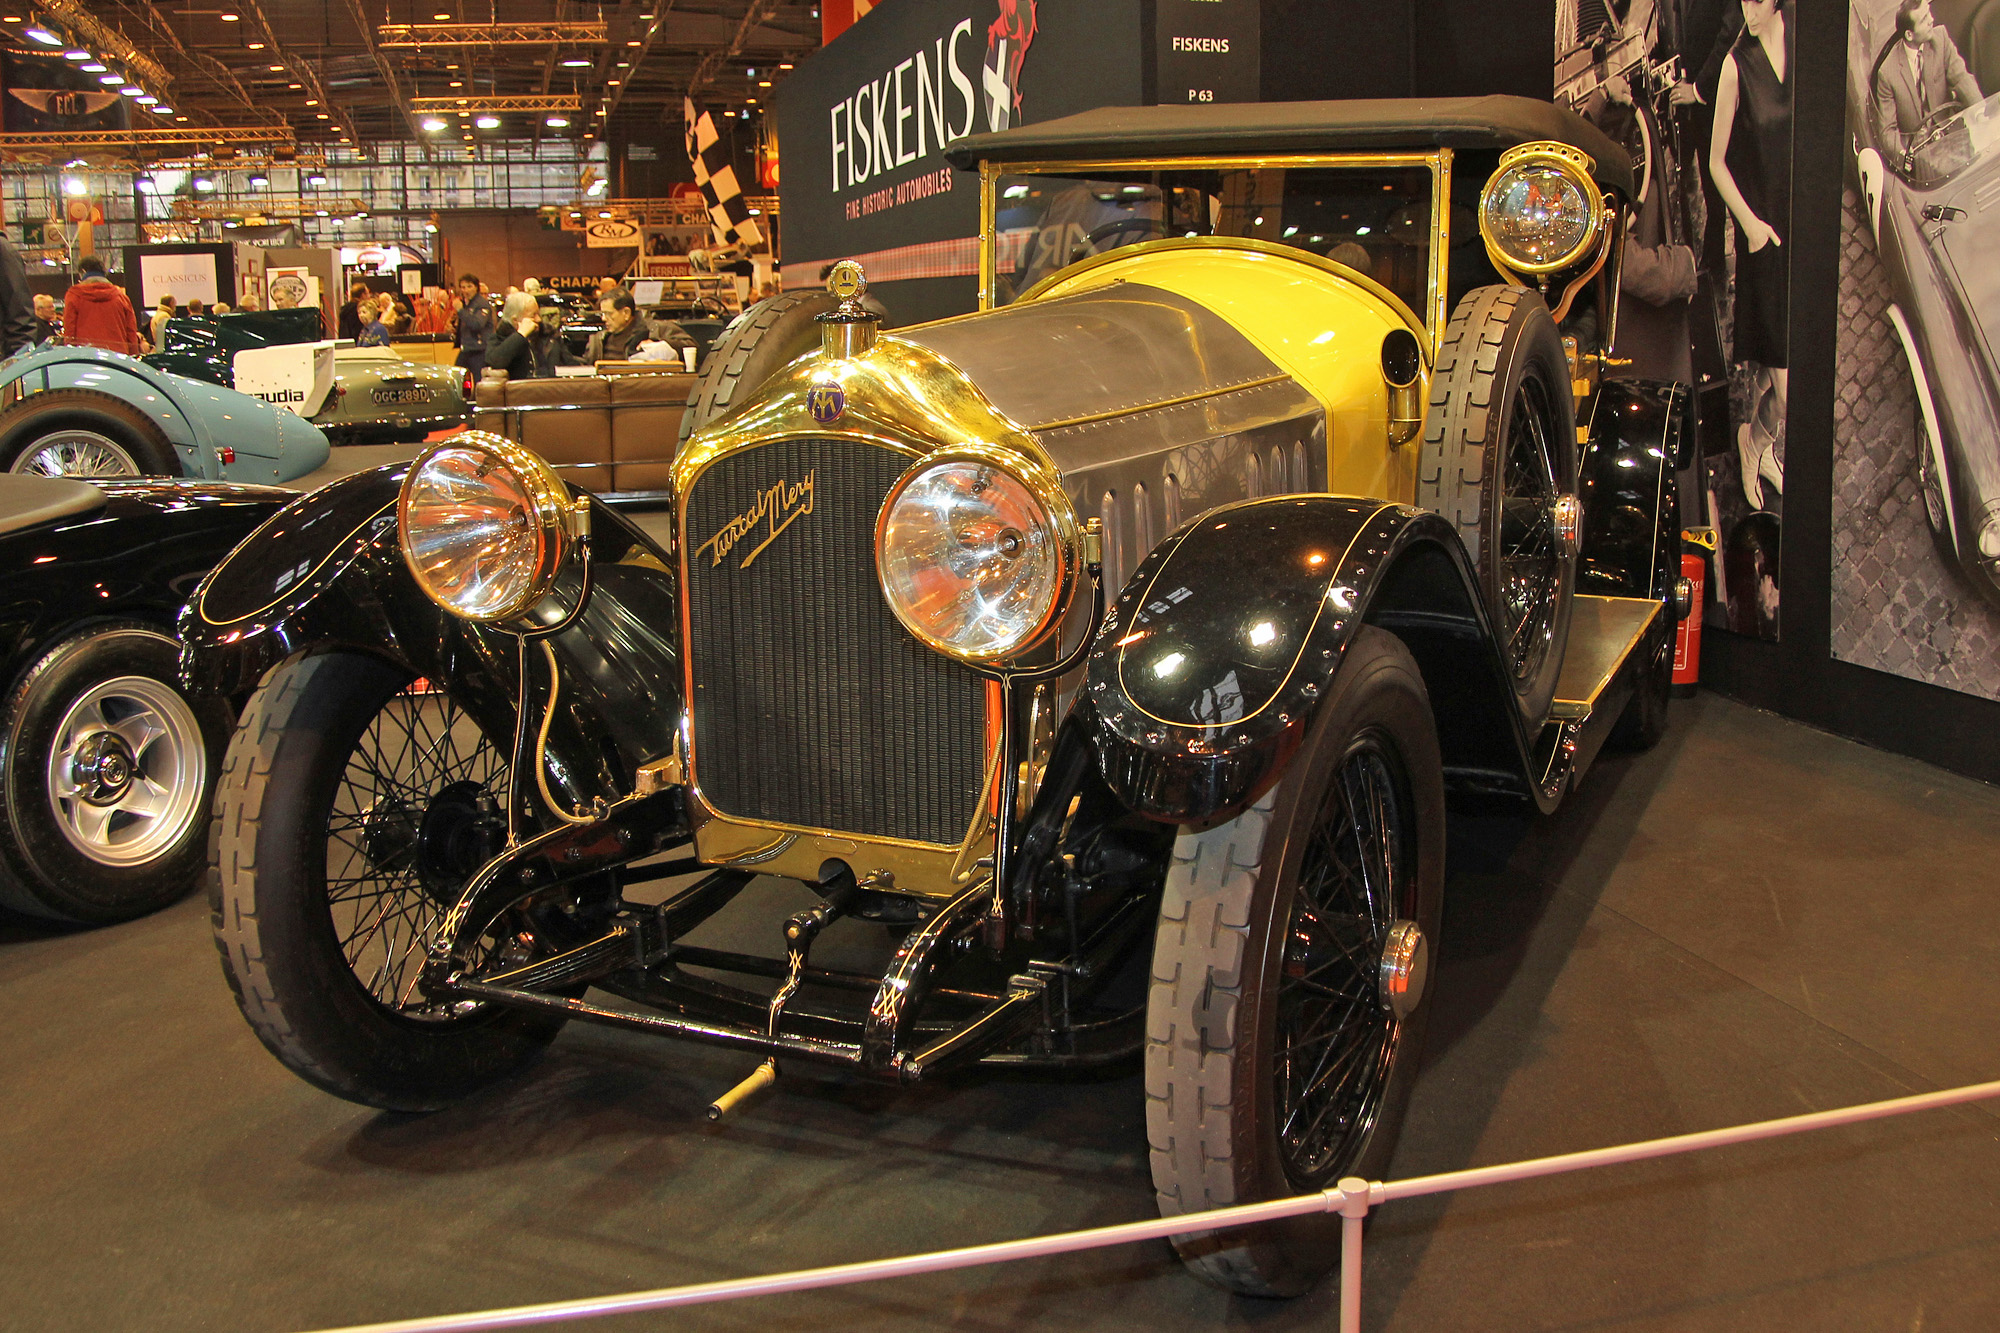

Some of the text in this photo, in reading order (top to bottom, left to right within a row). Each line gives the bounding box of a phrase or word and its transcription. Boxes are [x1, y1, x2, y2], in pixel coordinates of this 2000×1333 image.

[1172, 37, 1230, 53] FISKENS
[1188, 89, 1213, 102] P 63
[830, 17, 975, 193] FISKENS
[846, 167, 952, 220] FINE HISTORIC AUTOMOBILES
[682, 213, 708, 225] CHA
[650, 265, 688, 276] FERRARI
[152, 274, 207, 284] CLASSICUS
[549, 276, 603, 288] CHAPA
[249, 389, 304, 403] audia
[374, 391, 397, 403] OGC
[398, 388, 427, 401] 289D
